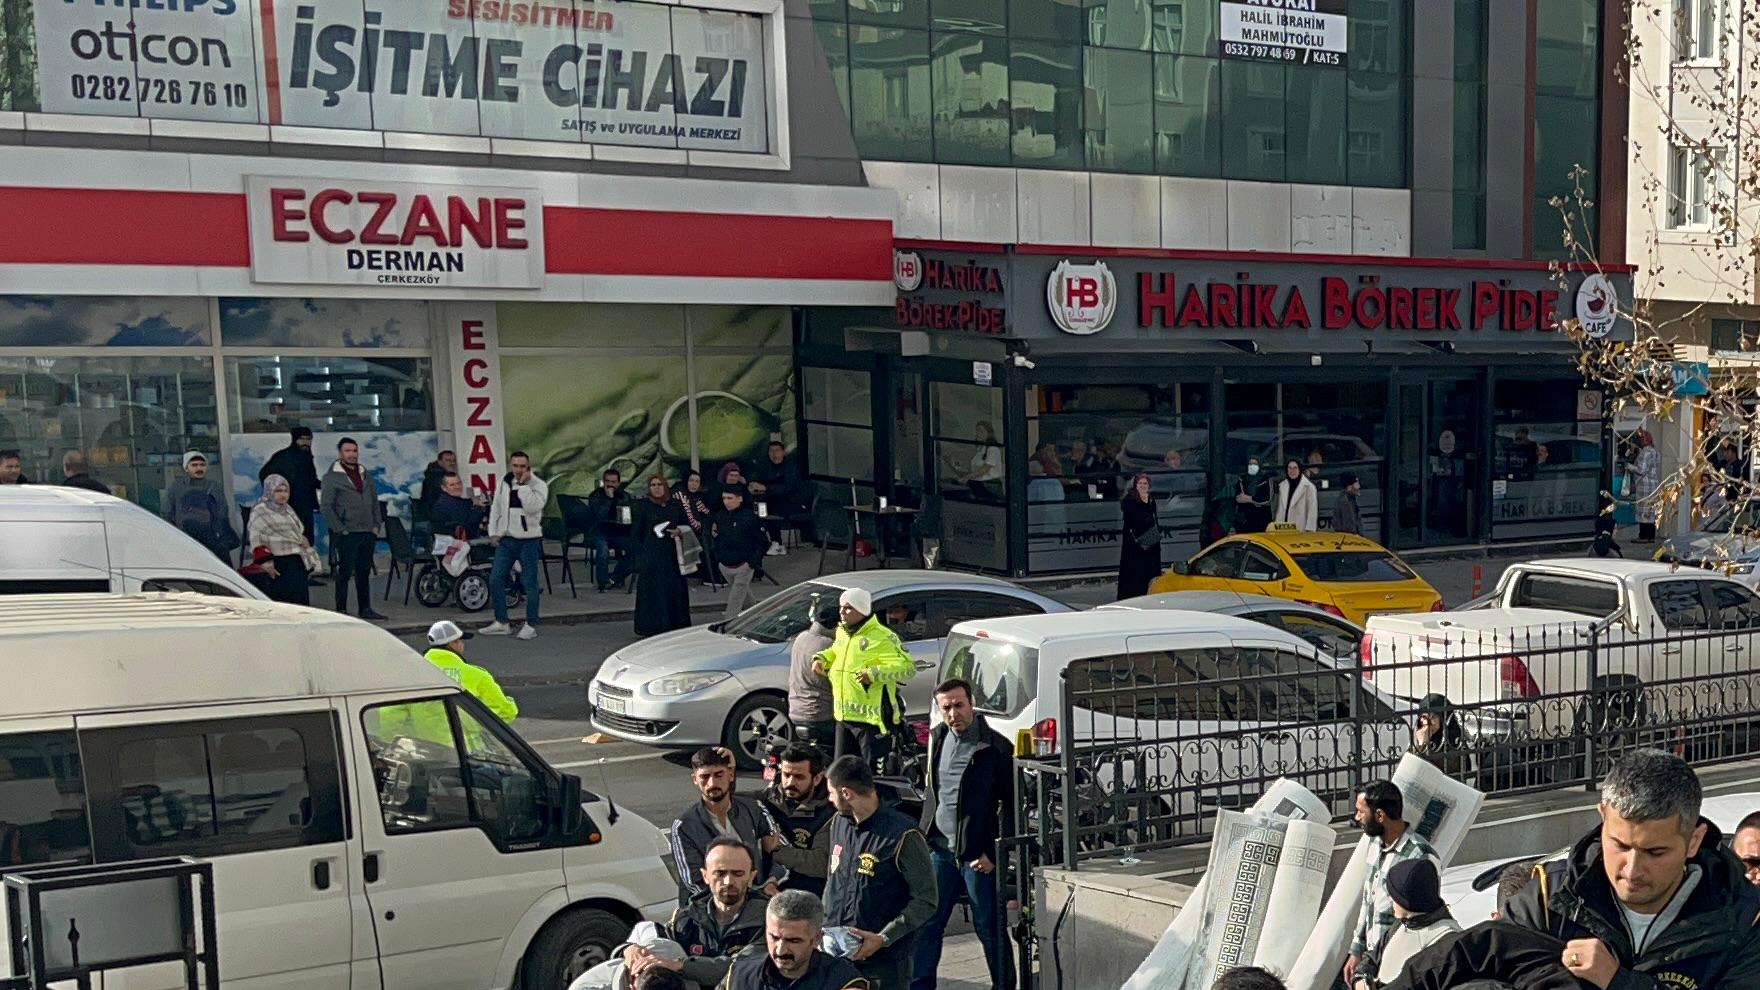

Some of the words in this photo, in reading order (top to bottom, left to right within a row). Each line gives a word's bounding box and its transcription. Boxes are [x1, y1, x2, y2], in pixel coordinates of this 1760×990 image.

[1240, 10, 1272, 25] HALİL
[1277, 13, 1325, 30] İBRAHİM
[70, 21, 232, 68] oticon
[1225, 43, 1249, 56] 0532
[1250, 45, 1267, 57] 797
[1269, 47, 1282, 59] 48
[1241, 28, 1324, 47] MAHMUTOĞLU
[289, 5, 523, 107] İŞİTME
[542, 42, 748, 119] CİHAZI
[71, 74, 131, 101] 0282
[138, 78, 182, 104] 726
[189, 81, 217, 106] 76
[223, 83, 247, 108] 10
[561, 119, 597, 135] SATIŞ
[601, 123, 615, 133] ve
[618, 122, 686, 138] UYGULAMA
[689, 127, 742, 141] MERKEZİ
[270, 187, 528, 250] ECZANE
[347, 248, 465, 273] DERMAN
[1066, 277, 1099, 308] HB
[1138, 270, 1311, 329] HARİKA
[1321, 275, 1462, 331] BÖREK
[1470, 278, 1559, 332] PİDE
[461, 320, 497, 499] ECZAN
